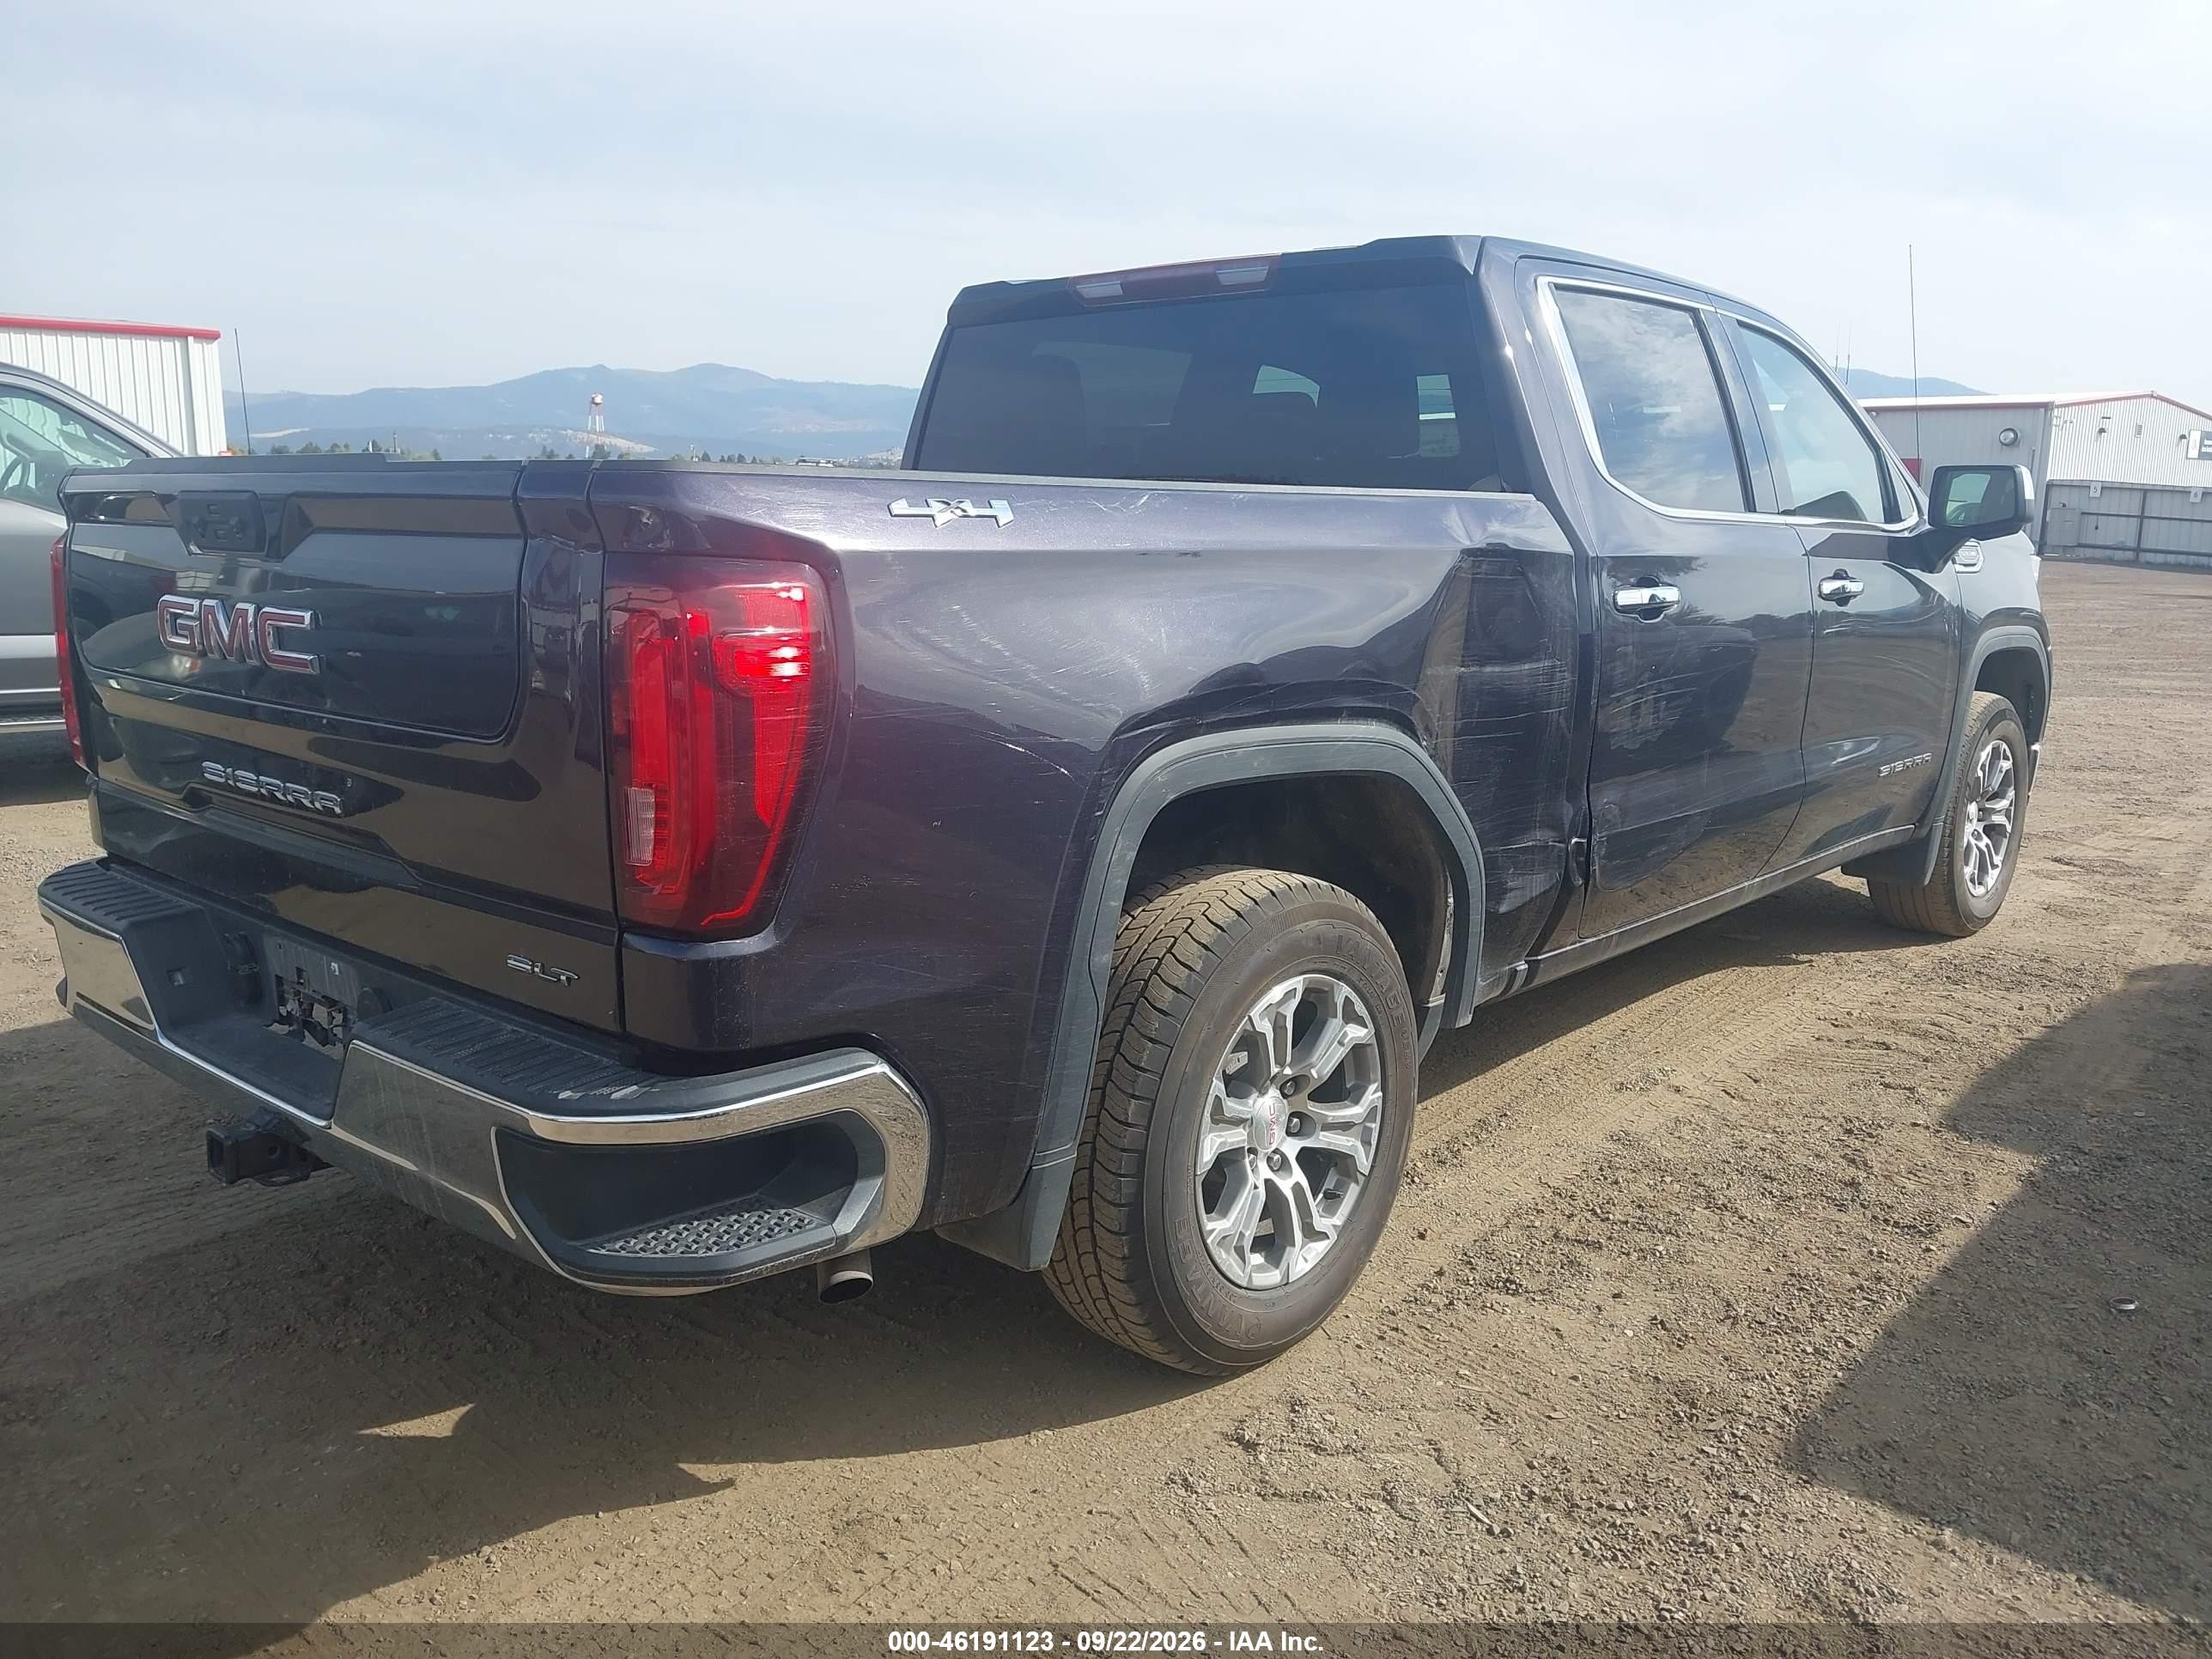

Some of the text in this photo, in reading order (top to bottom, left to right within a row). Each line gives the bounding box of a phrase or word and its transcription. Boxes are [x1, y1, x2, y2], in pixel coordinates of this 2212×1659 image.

[158, 594, 321, 674] GMC
[1878, 752, 1933, 777] SIERRA
[202, 761, 343, 815] SIERRA
[506, 953, 580, 987] SLT
[1268, 1103, 1278, 1146] GMC
